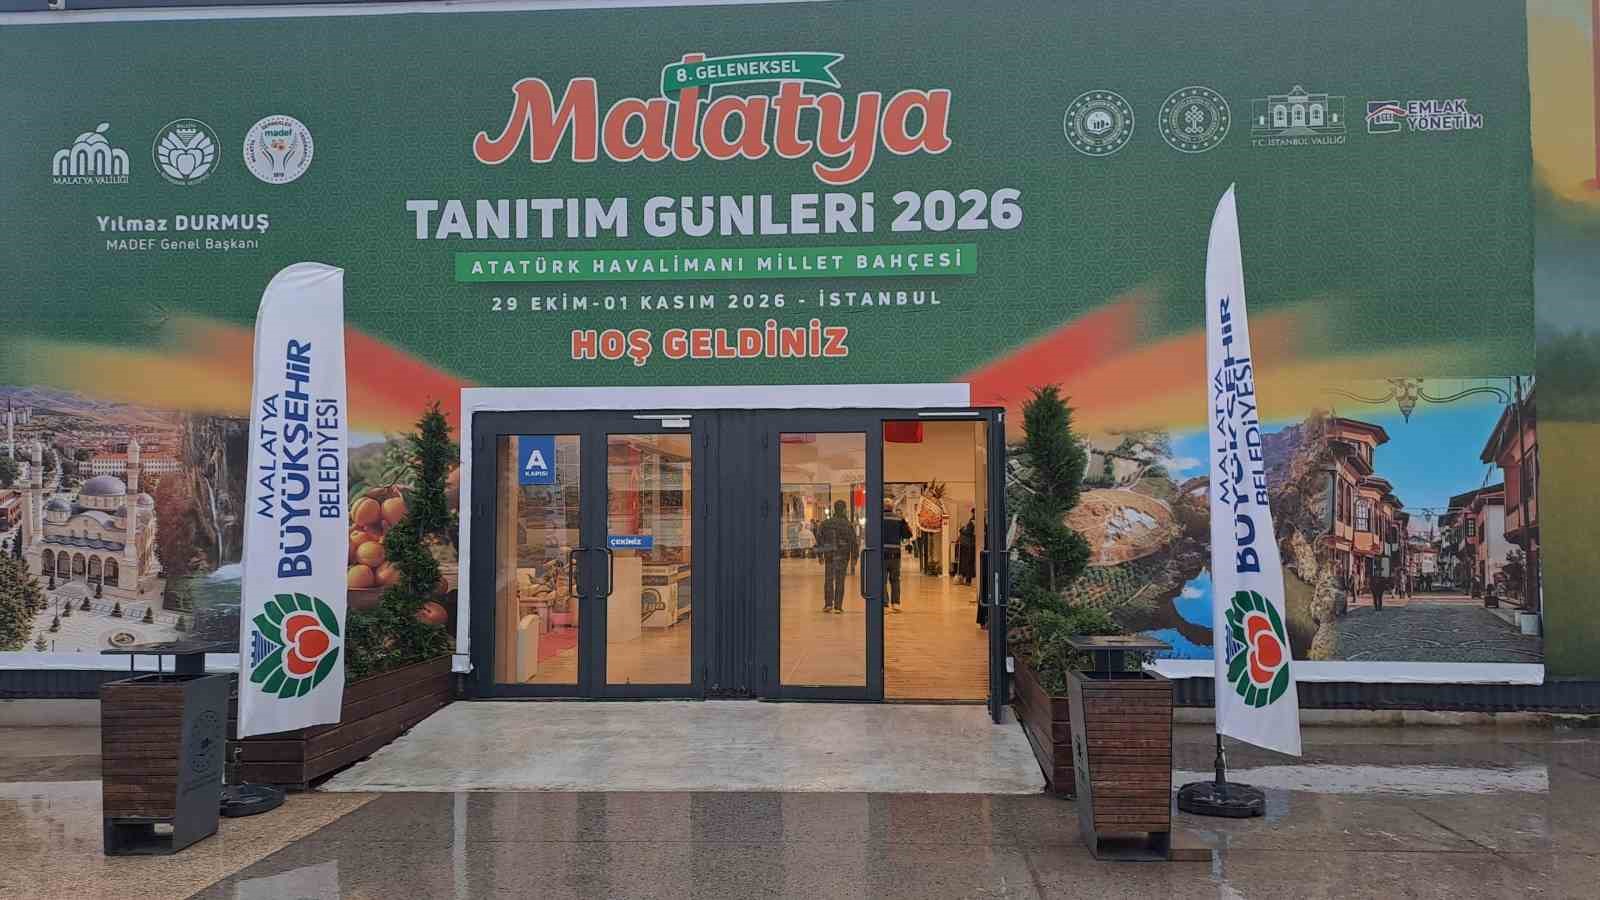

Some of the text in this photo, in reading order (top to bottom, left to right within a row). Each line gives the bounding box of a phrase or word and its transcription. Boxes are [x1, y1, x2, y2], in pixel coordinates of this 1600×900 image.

[676, 60, 801, 82] 8. GELENEKSEL
[1407, 99, 1469, 114] EMLAK
[473, 52, 952, 186] Malatya
[1407, 113, 1484, 131] YÖNETİM
[52, 175, 94, 185] MALATYA
[97, 213, 270, 234] Yılmaz DURMUŞ
[405, 187, 1023, 240] TANITIM GÜNLERİ 2026
[105, 237, 259, 251] MADEF Genel Başkanı
[471, 248, 962, 275] ATATÜRK HAVALİMANI MİLLET BAHÇESİ
[491, 296, 519, 311] 29
[530, 293, 629, 311] EKİM-01
[640, 294, 715, 310] KASIM
[727, 294, 786, 309] 2026
[818, 289, 941, 307] İSTANBUL
[571, 318, 849, 367] HOŞ GELDİNİZ
[1214, 367, 1230, 505] MALATYA
[257, 393, 280, 519] MALATYA
[316, 398, 341, 519] BELEDİYESİ
[525, 449, 548, 470] A
